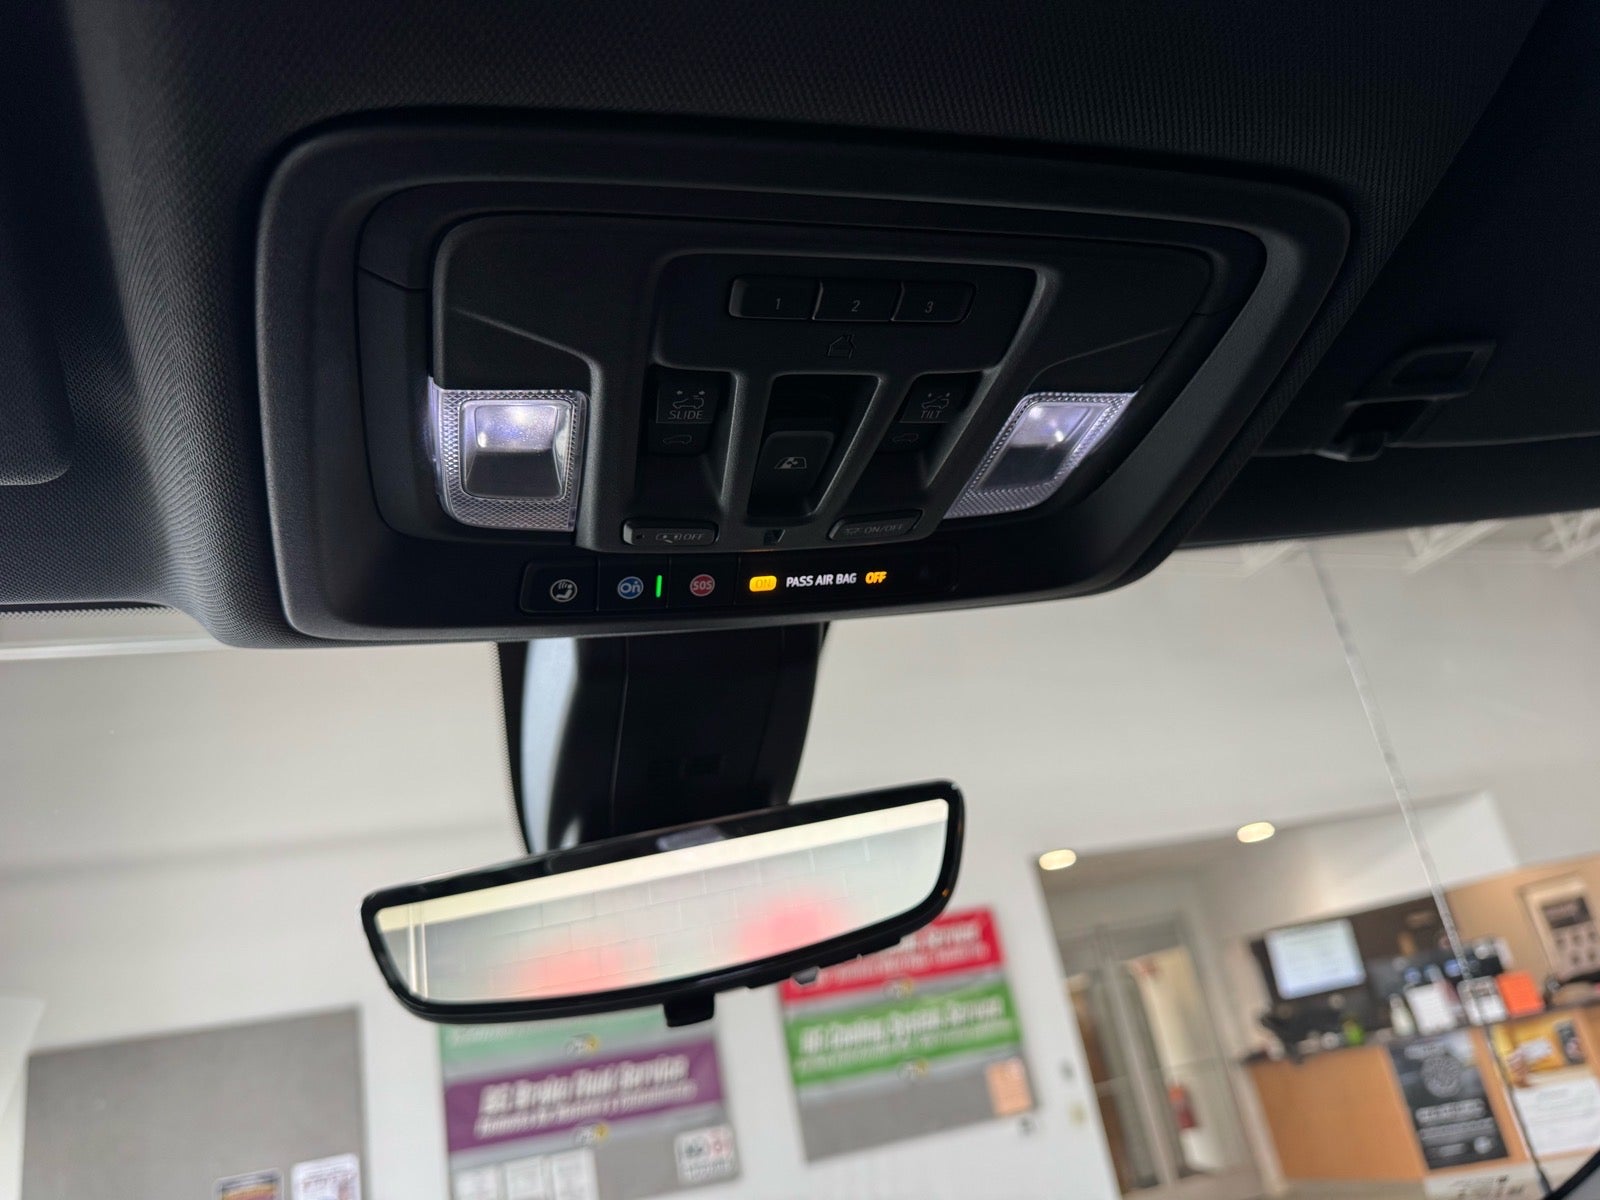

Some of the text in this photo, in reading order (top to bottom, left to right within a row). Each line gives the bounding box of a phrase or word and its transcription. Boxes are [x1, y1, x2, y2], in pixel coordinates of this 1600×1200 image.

[774, 297, 782, 311] 1
[851, 300, 861, 313] 2
[924, 301, 935, 314] 3
[668, 409, 704, 421] SLIDE
[920, 409, 942, 420] TILT
[864, 523, 903, 536] ON/OFF
[682, 532, 705, 542] OFF
[690, 578, 714, 592] SOS
[785, 576, 813, 588] PASS
[814, 574, 834, 587] AIR
[835, 572, 857, 586] BAG
[864, 571, 888, 584] OFF
